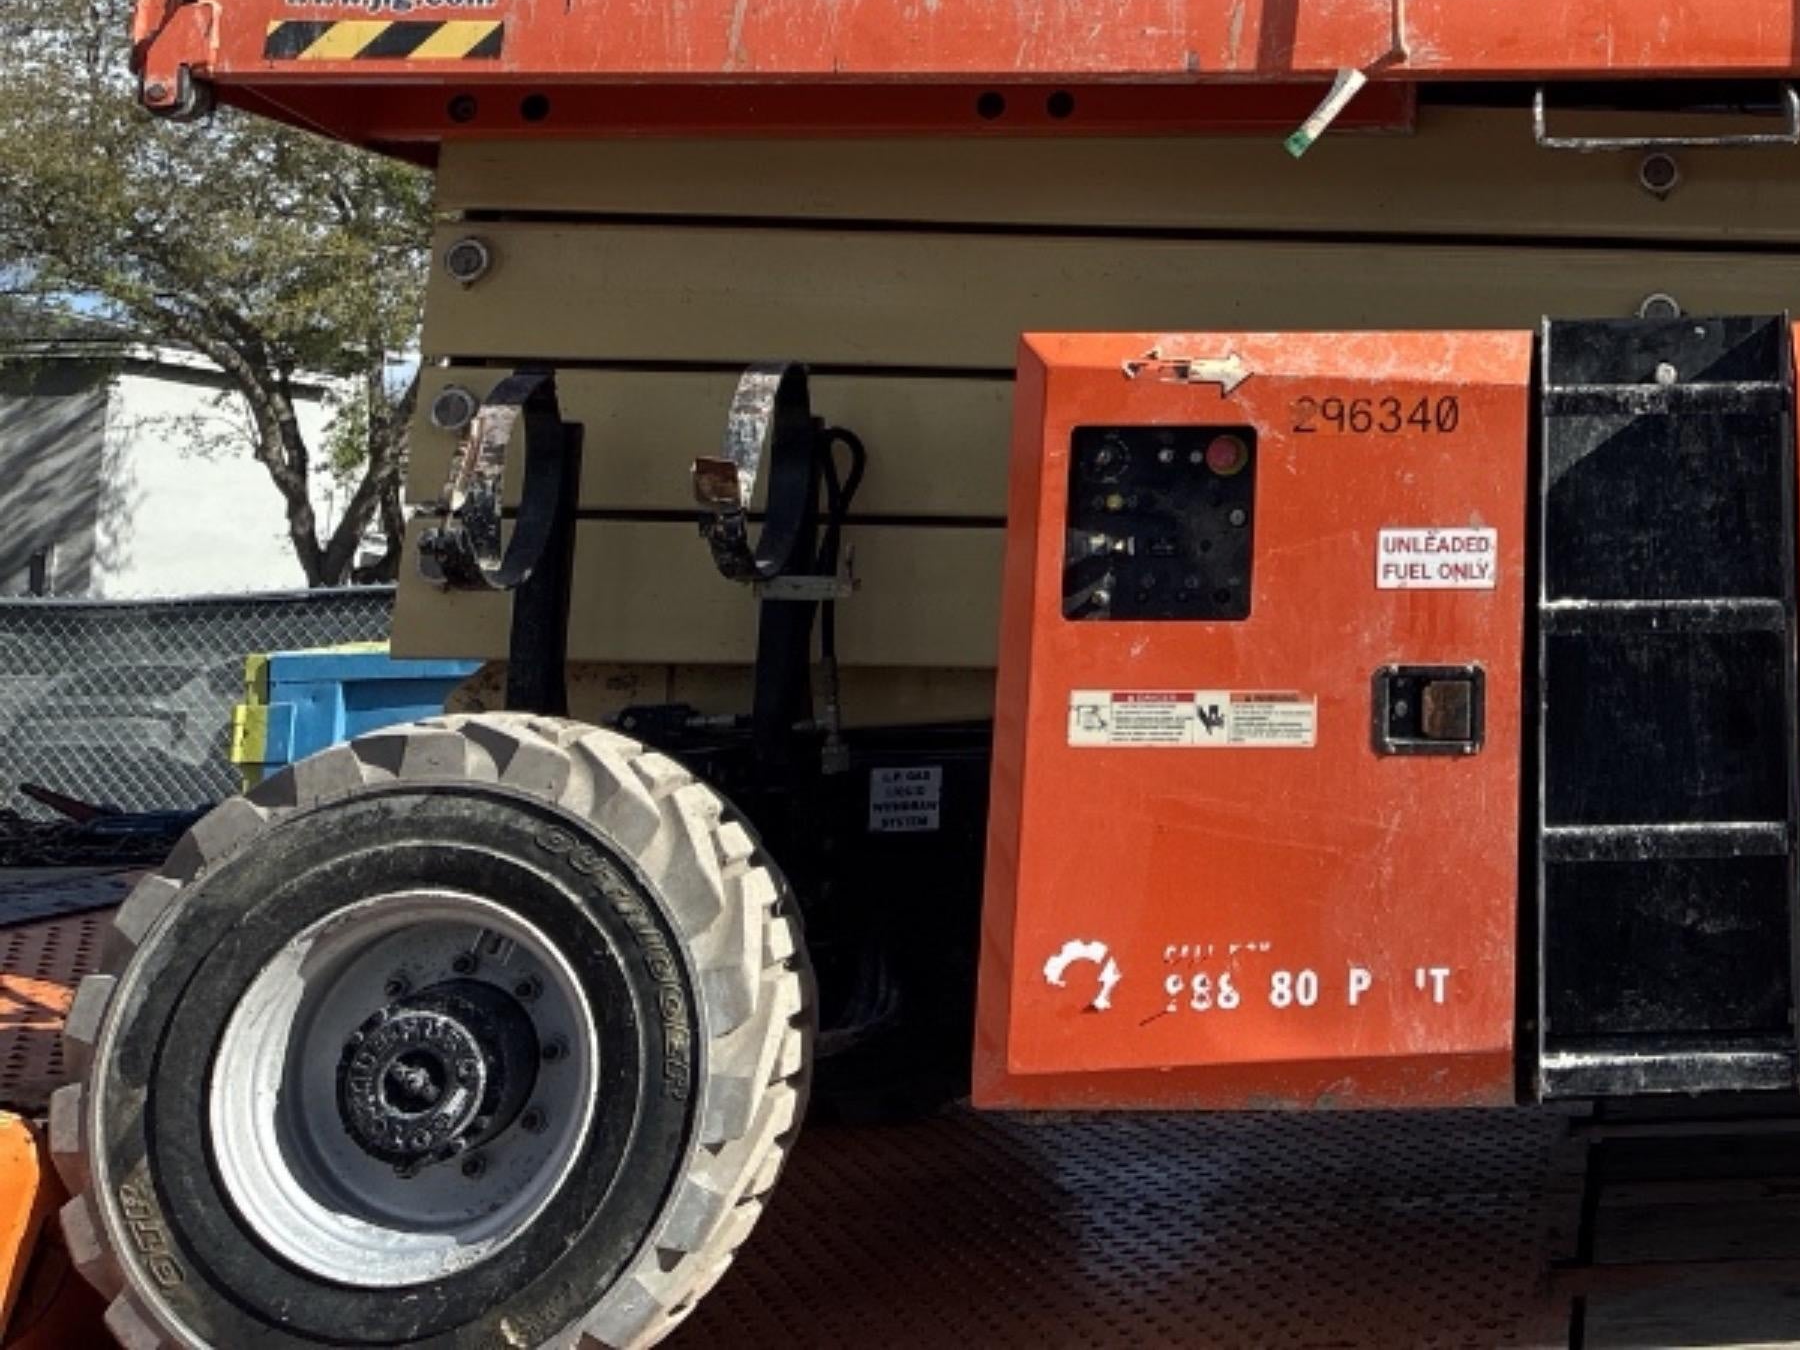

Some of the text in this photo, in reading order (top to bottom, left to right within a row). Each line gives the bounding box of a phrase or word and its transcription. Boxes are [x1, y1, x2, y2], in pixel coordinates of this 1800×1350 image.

[1292, 395, 1461, 434] 296340
[1383, 536, 1490, 554] UNLEADED
[1383, 562, 1432, 581] FUEL
[1270, 968, 1318, 1008] 80
